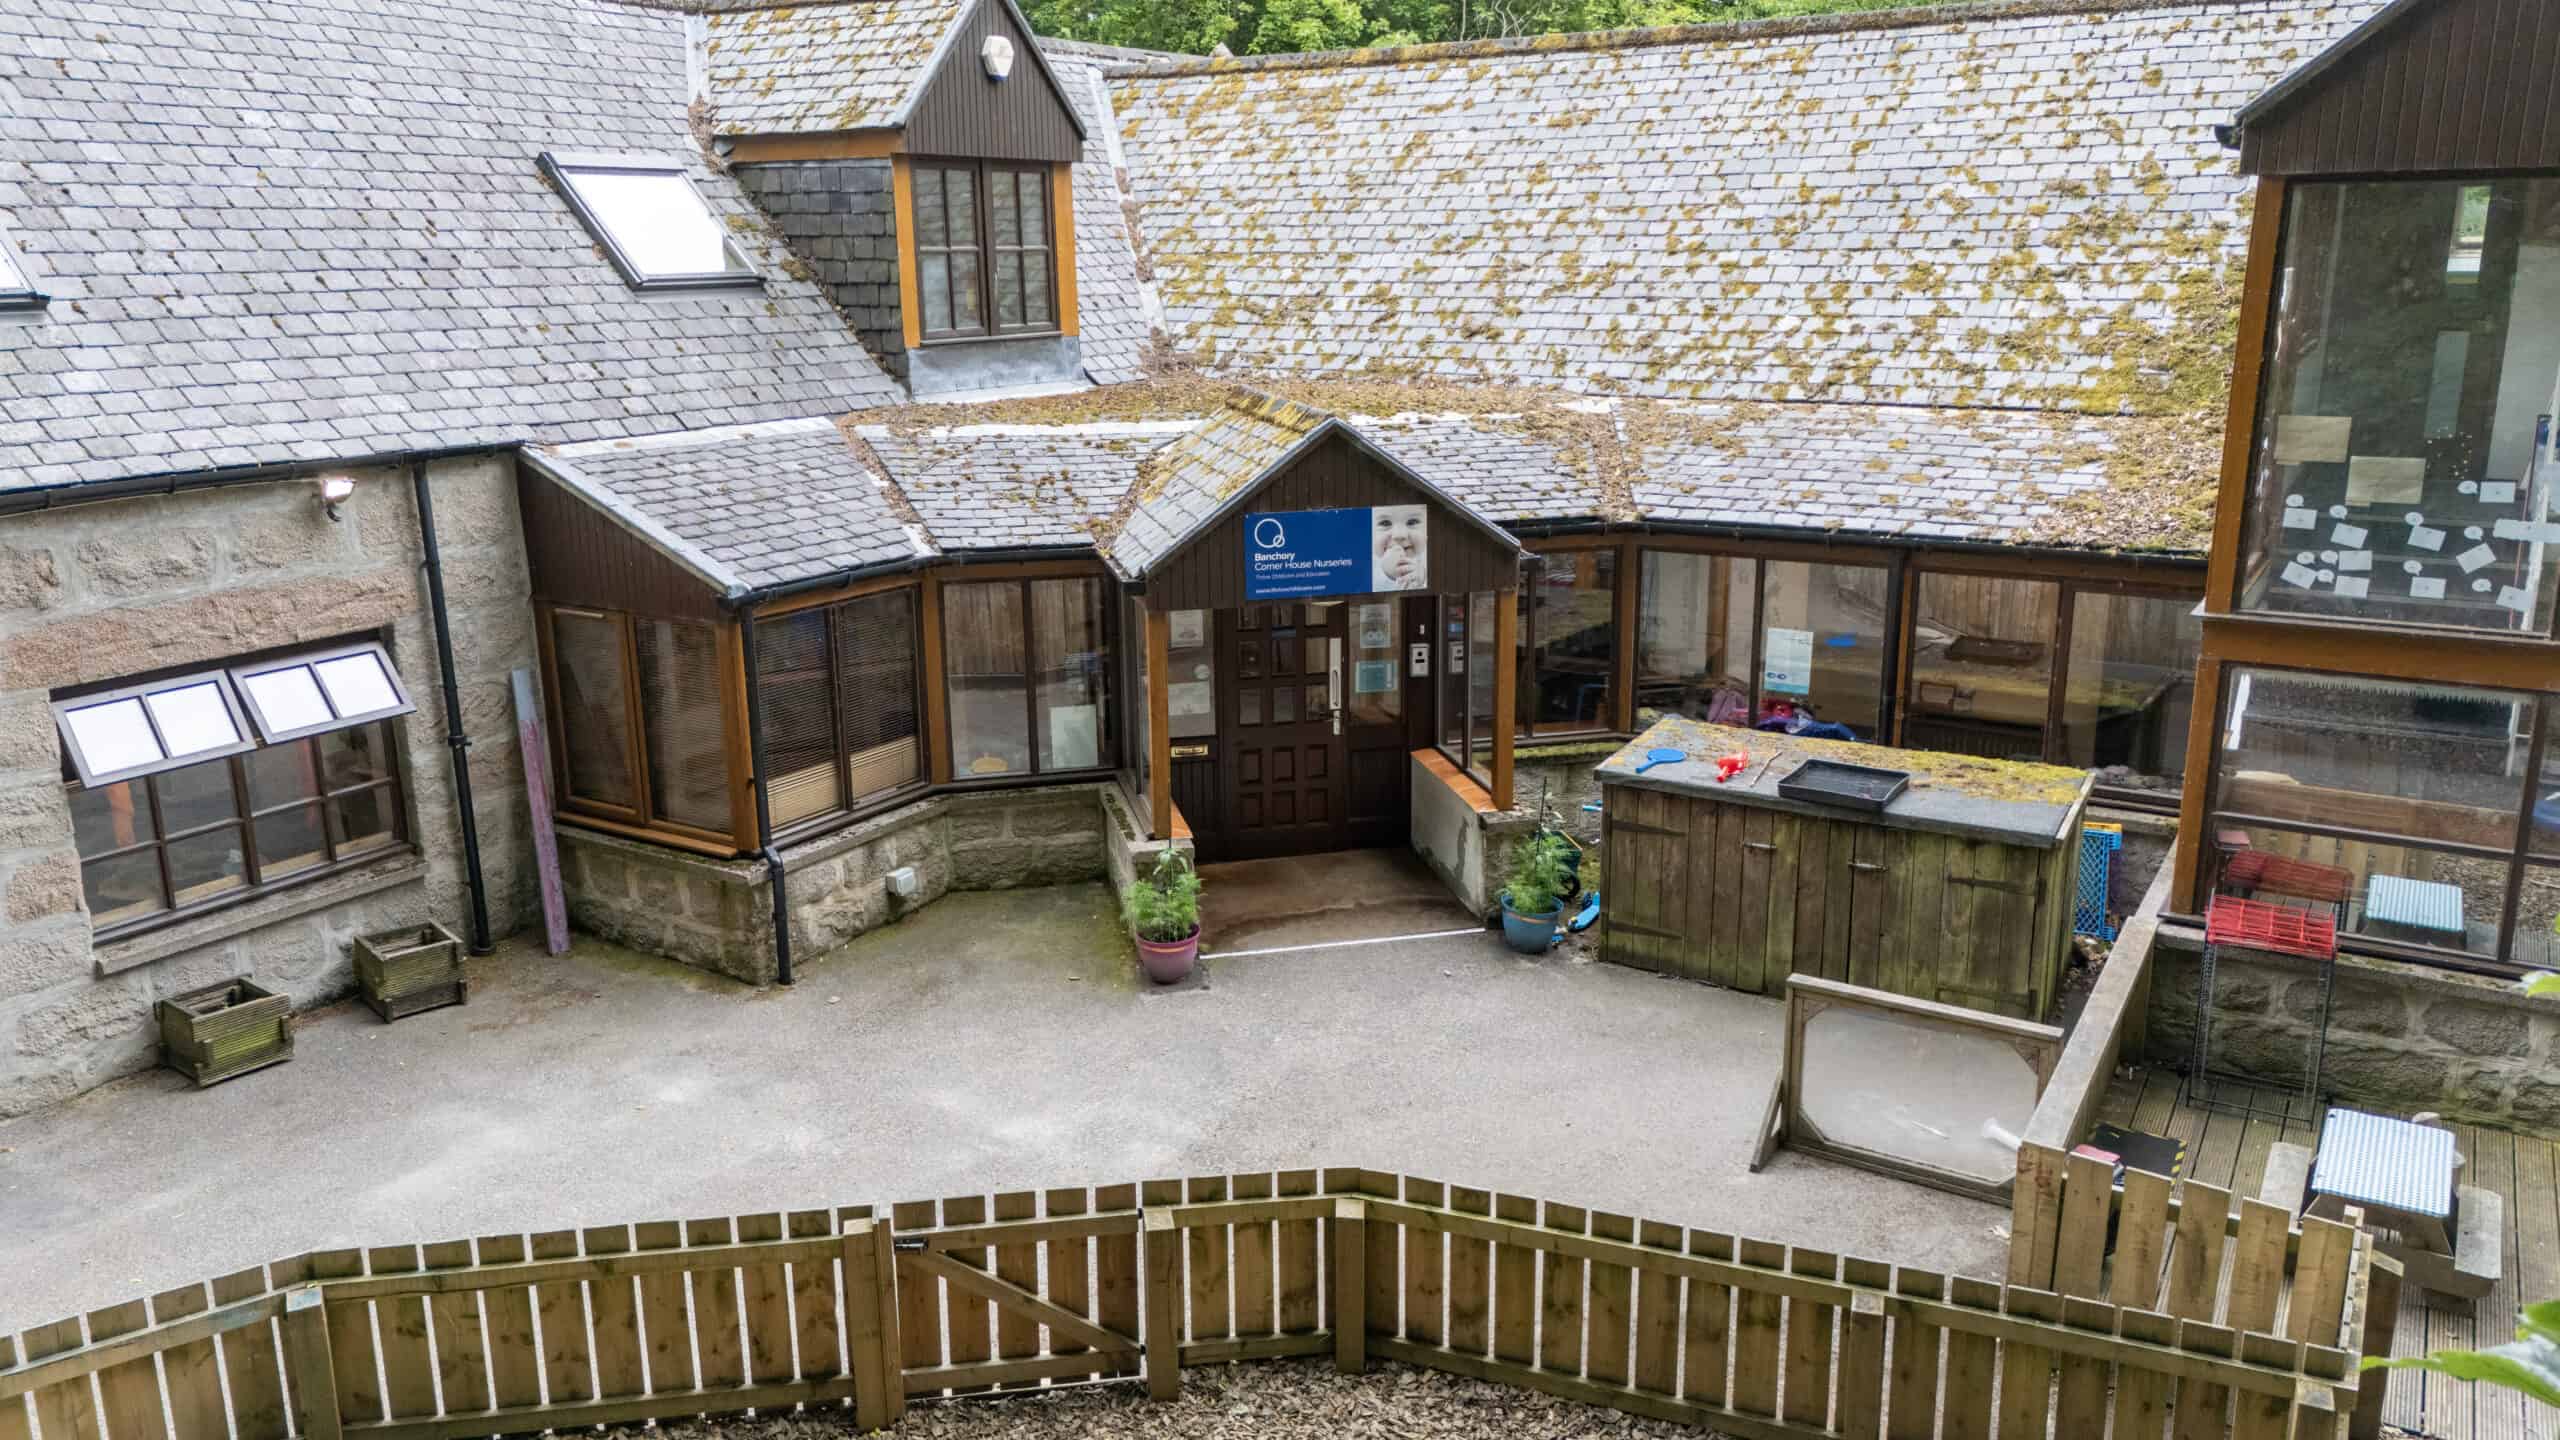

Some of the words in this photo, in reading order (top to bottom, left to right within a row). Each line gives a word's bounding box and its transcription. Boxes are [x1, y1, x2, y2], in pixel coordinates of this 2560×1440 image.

[1254, 551, 1296, 562] Banchory
[1254, 561, 1283, 571] Corner
[1284, 560, 1313, 569] House
[1313, 558, 1353, 568] Nurseries
